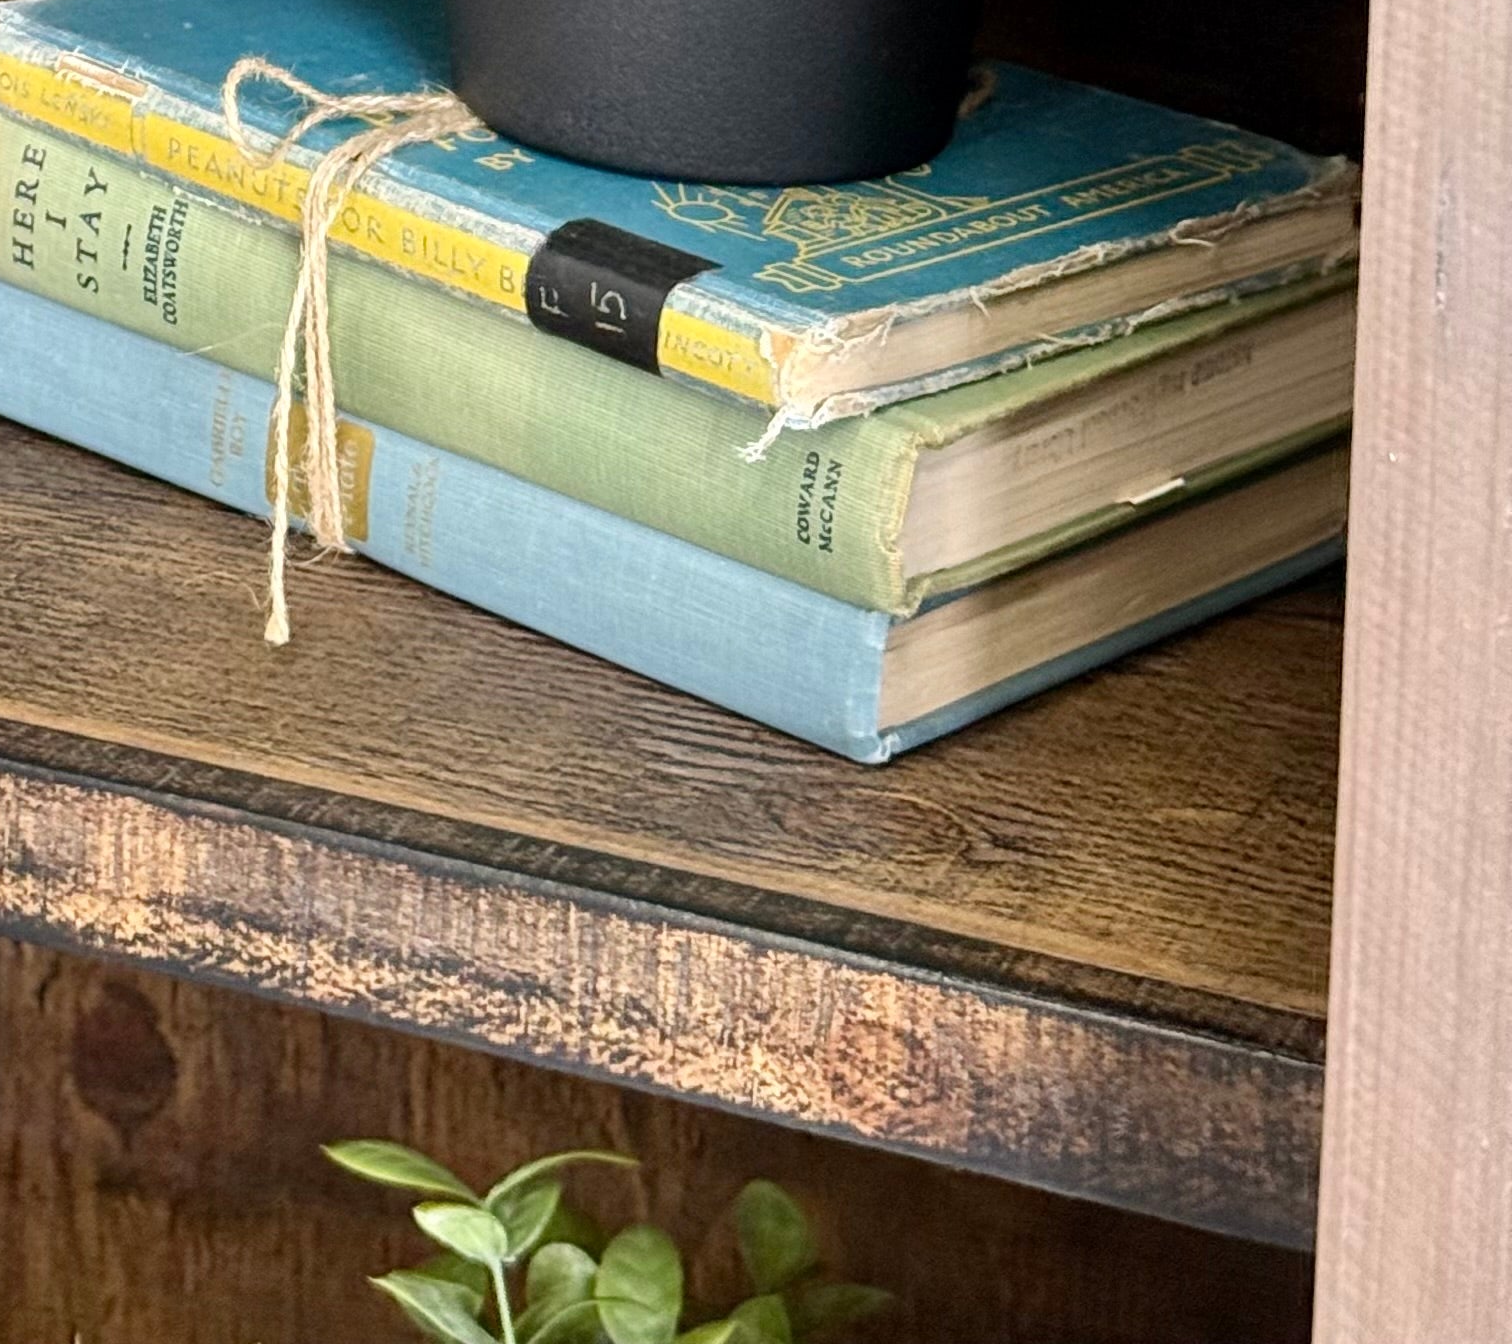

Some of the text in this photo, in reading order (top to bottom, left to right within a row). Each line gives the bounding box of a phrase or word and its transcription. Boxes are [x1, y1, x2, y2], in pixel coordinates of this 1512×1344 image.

[12, 143, 47, 271] HERE
[473, 148, 536, 172] BY
[44, 208, 67, 230] I
[76, 166, 109, 295] STAY
[143, 204, 168, 306] ELIZABETH
[161, 198, 190, 326] COATSWORTH
[401, 227, 487, 281] BILLY
[840, 204, 1051, 269] ROUNDABOUT
[796, 451, 820, 545] COWARD
